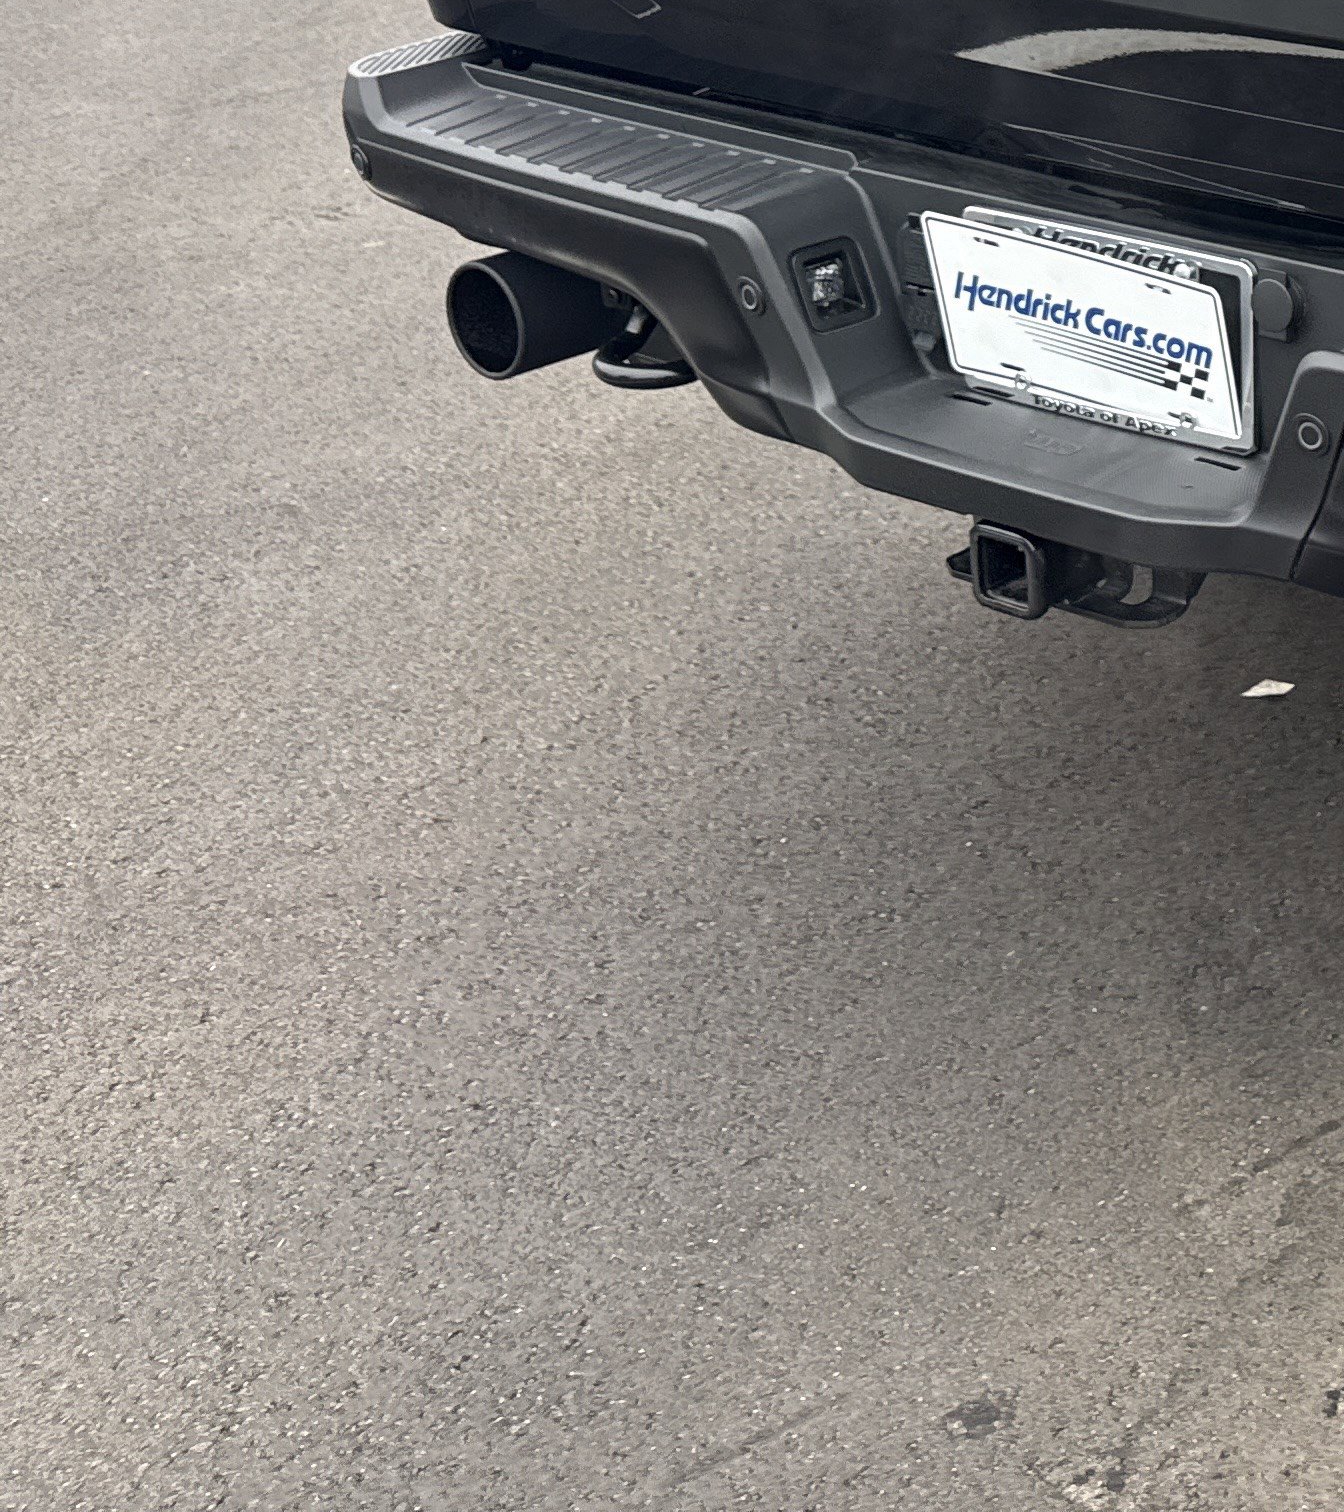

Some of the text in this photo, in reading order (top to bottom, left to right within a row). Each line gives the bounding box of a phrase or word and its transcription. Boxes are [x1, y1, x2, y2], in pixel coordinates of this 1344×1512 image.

[1031, 393, 1179, 437] Toyota of Apex
